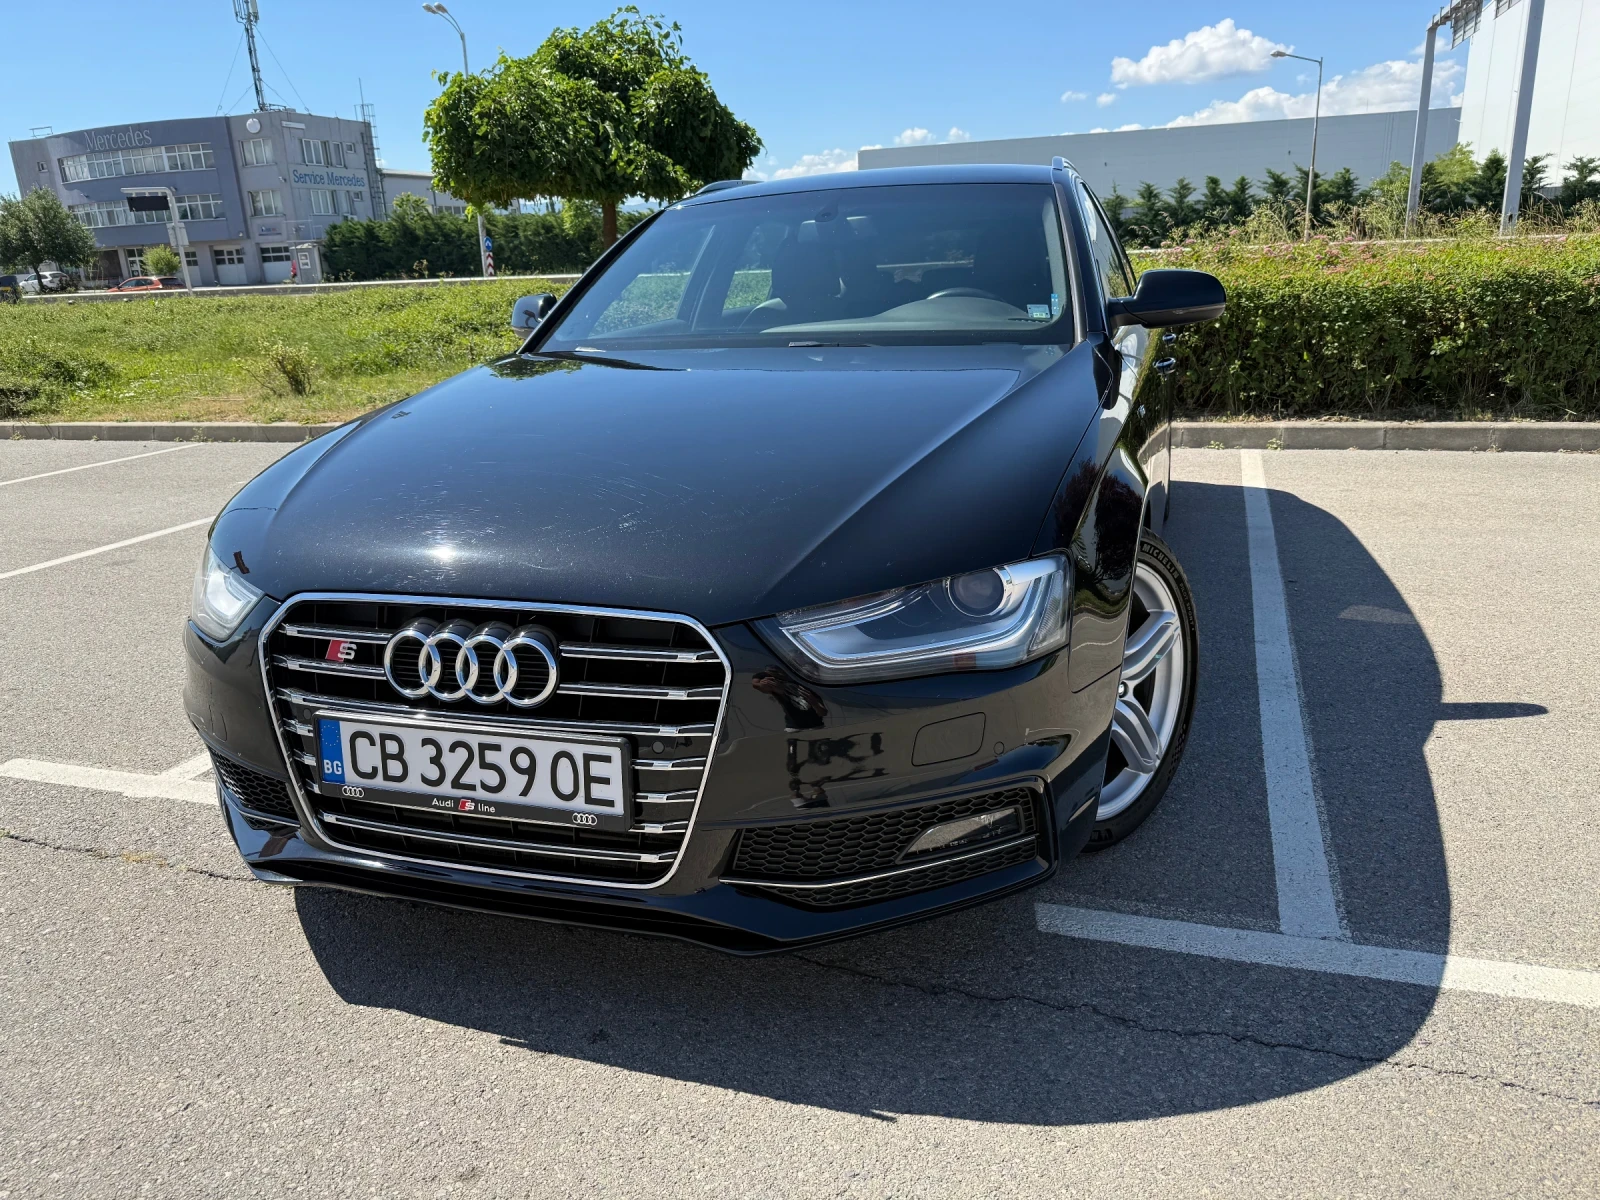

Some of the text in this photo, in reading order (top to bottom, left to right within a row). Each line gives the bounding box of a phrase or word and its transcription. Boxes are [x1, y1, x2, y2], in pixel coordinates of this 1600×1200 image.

[84, 126, 152, 151] Mercedes
[292, 169, 366, 187] Service Mercedes
[1143, 544, 1180, 579] MICHELIN
[1179, 583, 1195, 625] PILOT SPORT
[323, 759, 342, 775] BG
[349, 730, 409, 783] CB
[420, 737, 538, 797] 3259
[431, 797, 454, 808] Audi
[478, 803, 496, 813] line
